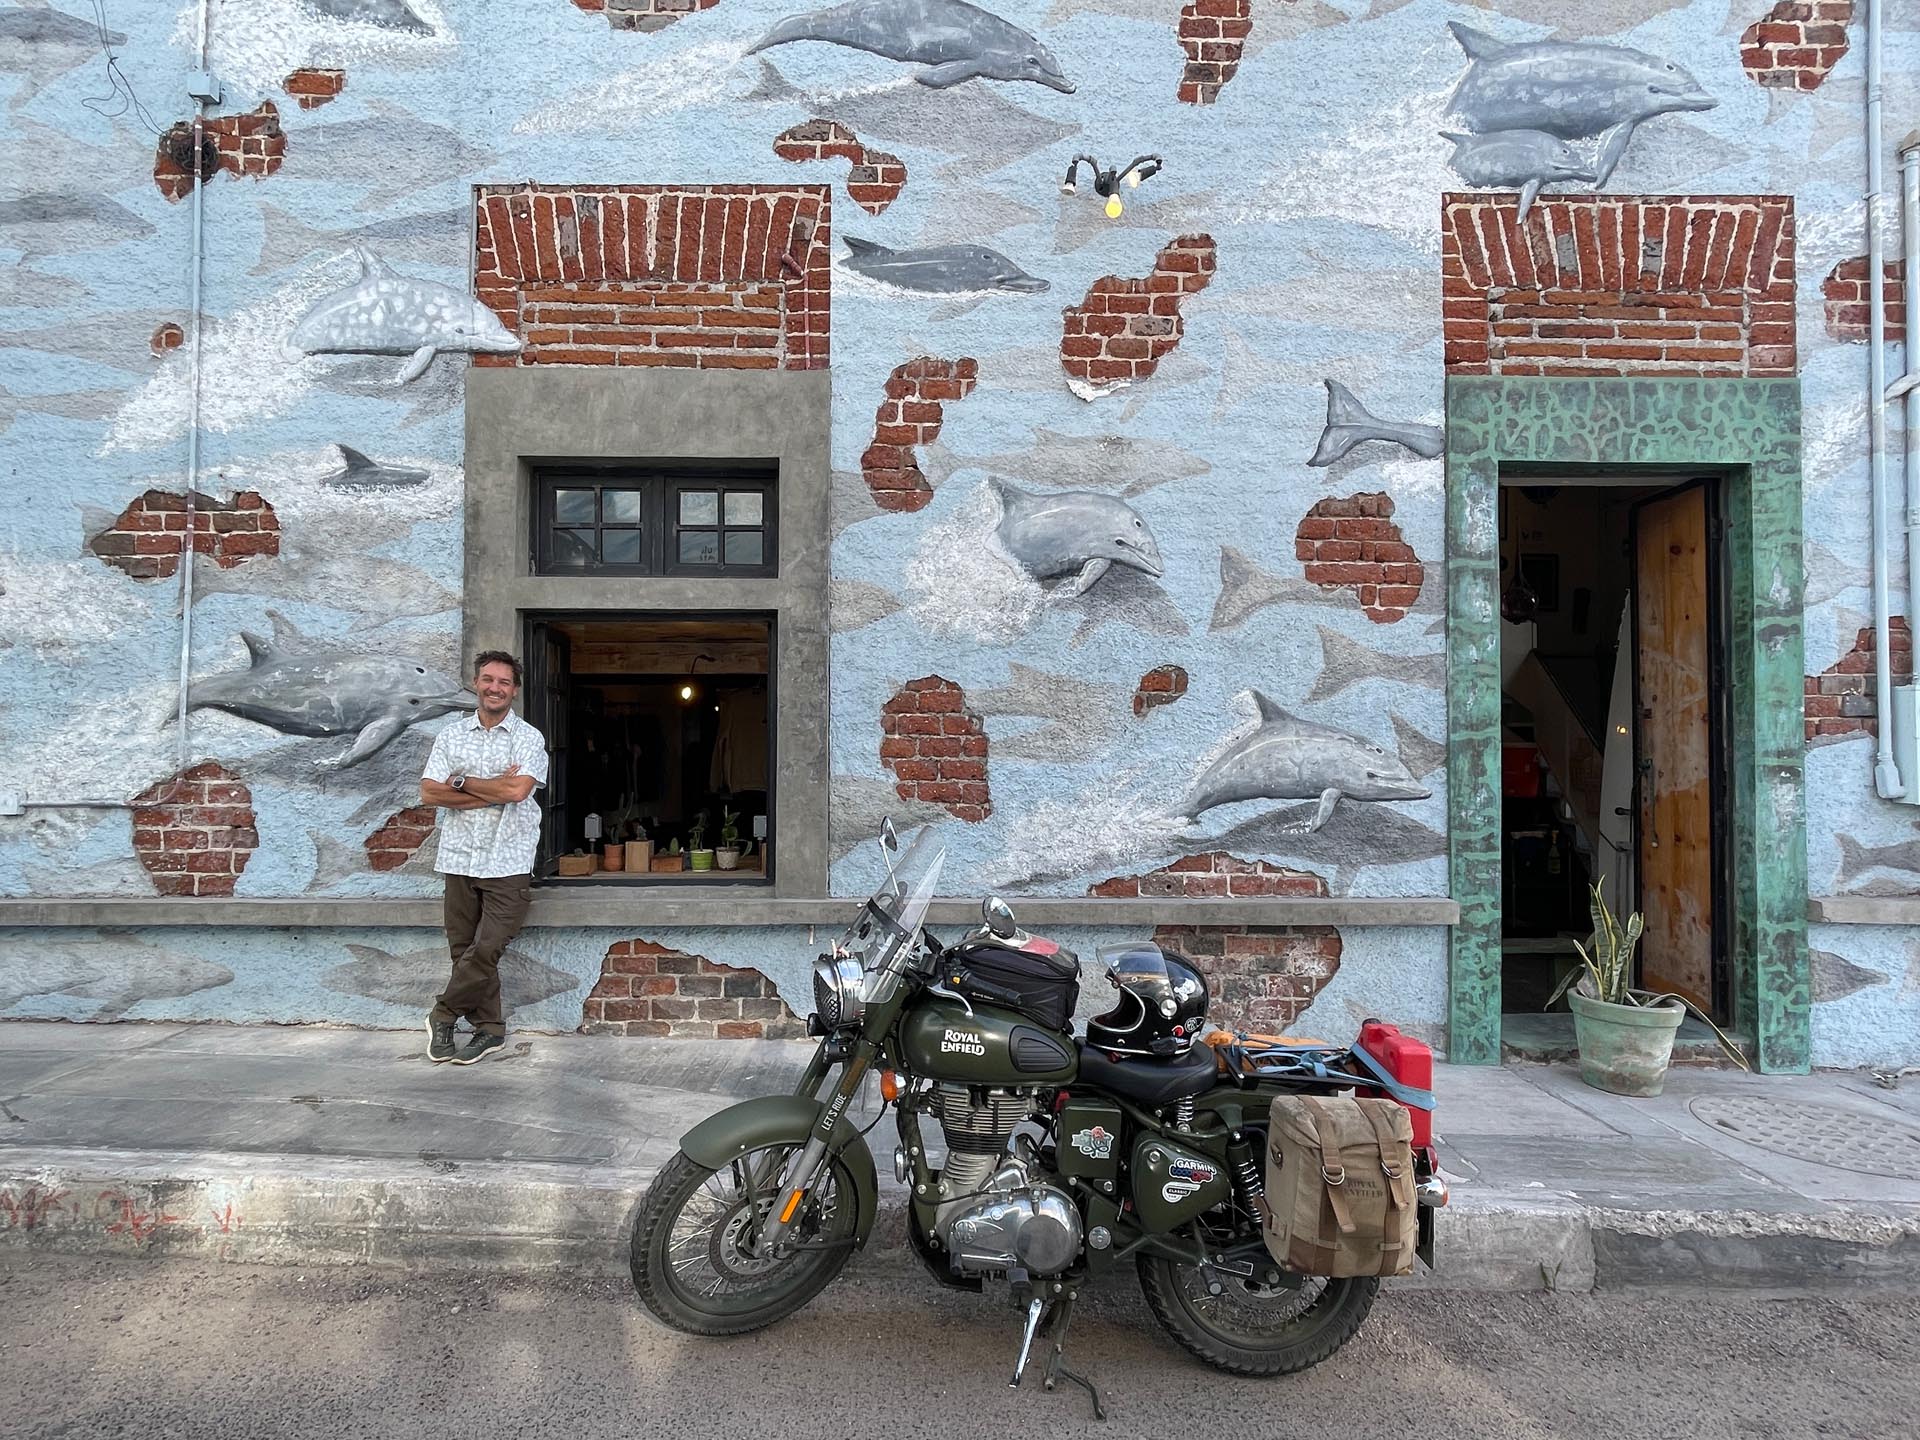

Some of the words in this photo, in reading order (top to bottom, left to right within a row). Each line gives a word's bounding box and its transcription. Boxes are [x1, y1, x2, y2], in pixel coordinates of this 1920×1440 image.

[945, 1029, 981, 1044] ROYAL
[941, 1041, 985, 1056] ENFIELD
[831, 1093, 847, 1111] RIDE
[1176, 1160, 1215, 1172] GARMIN
